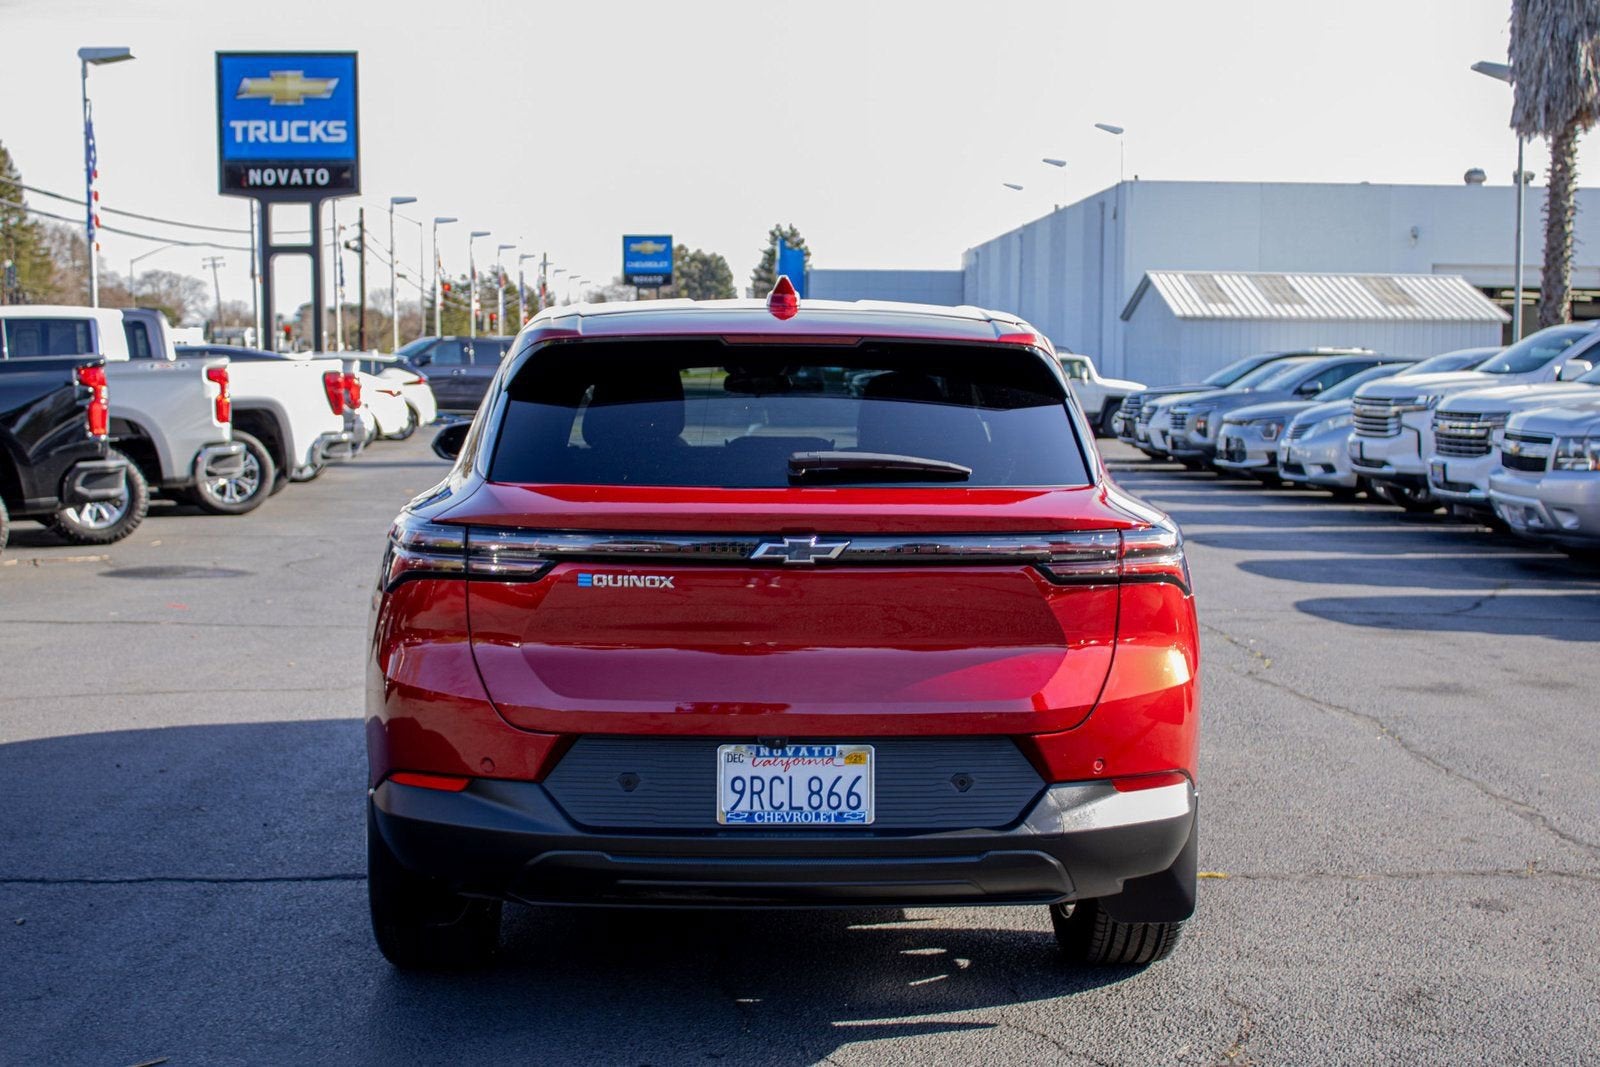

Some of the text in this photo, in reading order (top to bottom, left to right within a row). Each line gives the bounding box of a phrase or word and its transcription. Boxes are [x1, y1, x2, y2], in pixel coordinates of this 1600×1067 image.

[229, 120, 348, 143] TRUCKS
[248, 168, 330, 186] NOVATO
[577, 573, 675, 589] EQUINOX
[727, 753, 744, 763] DEC
[752, 756, 845, 772] California
[730, 775, 862, 811] 9RCL866
[754, 811, 837, 823] CHEVROLET
